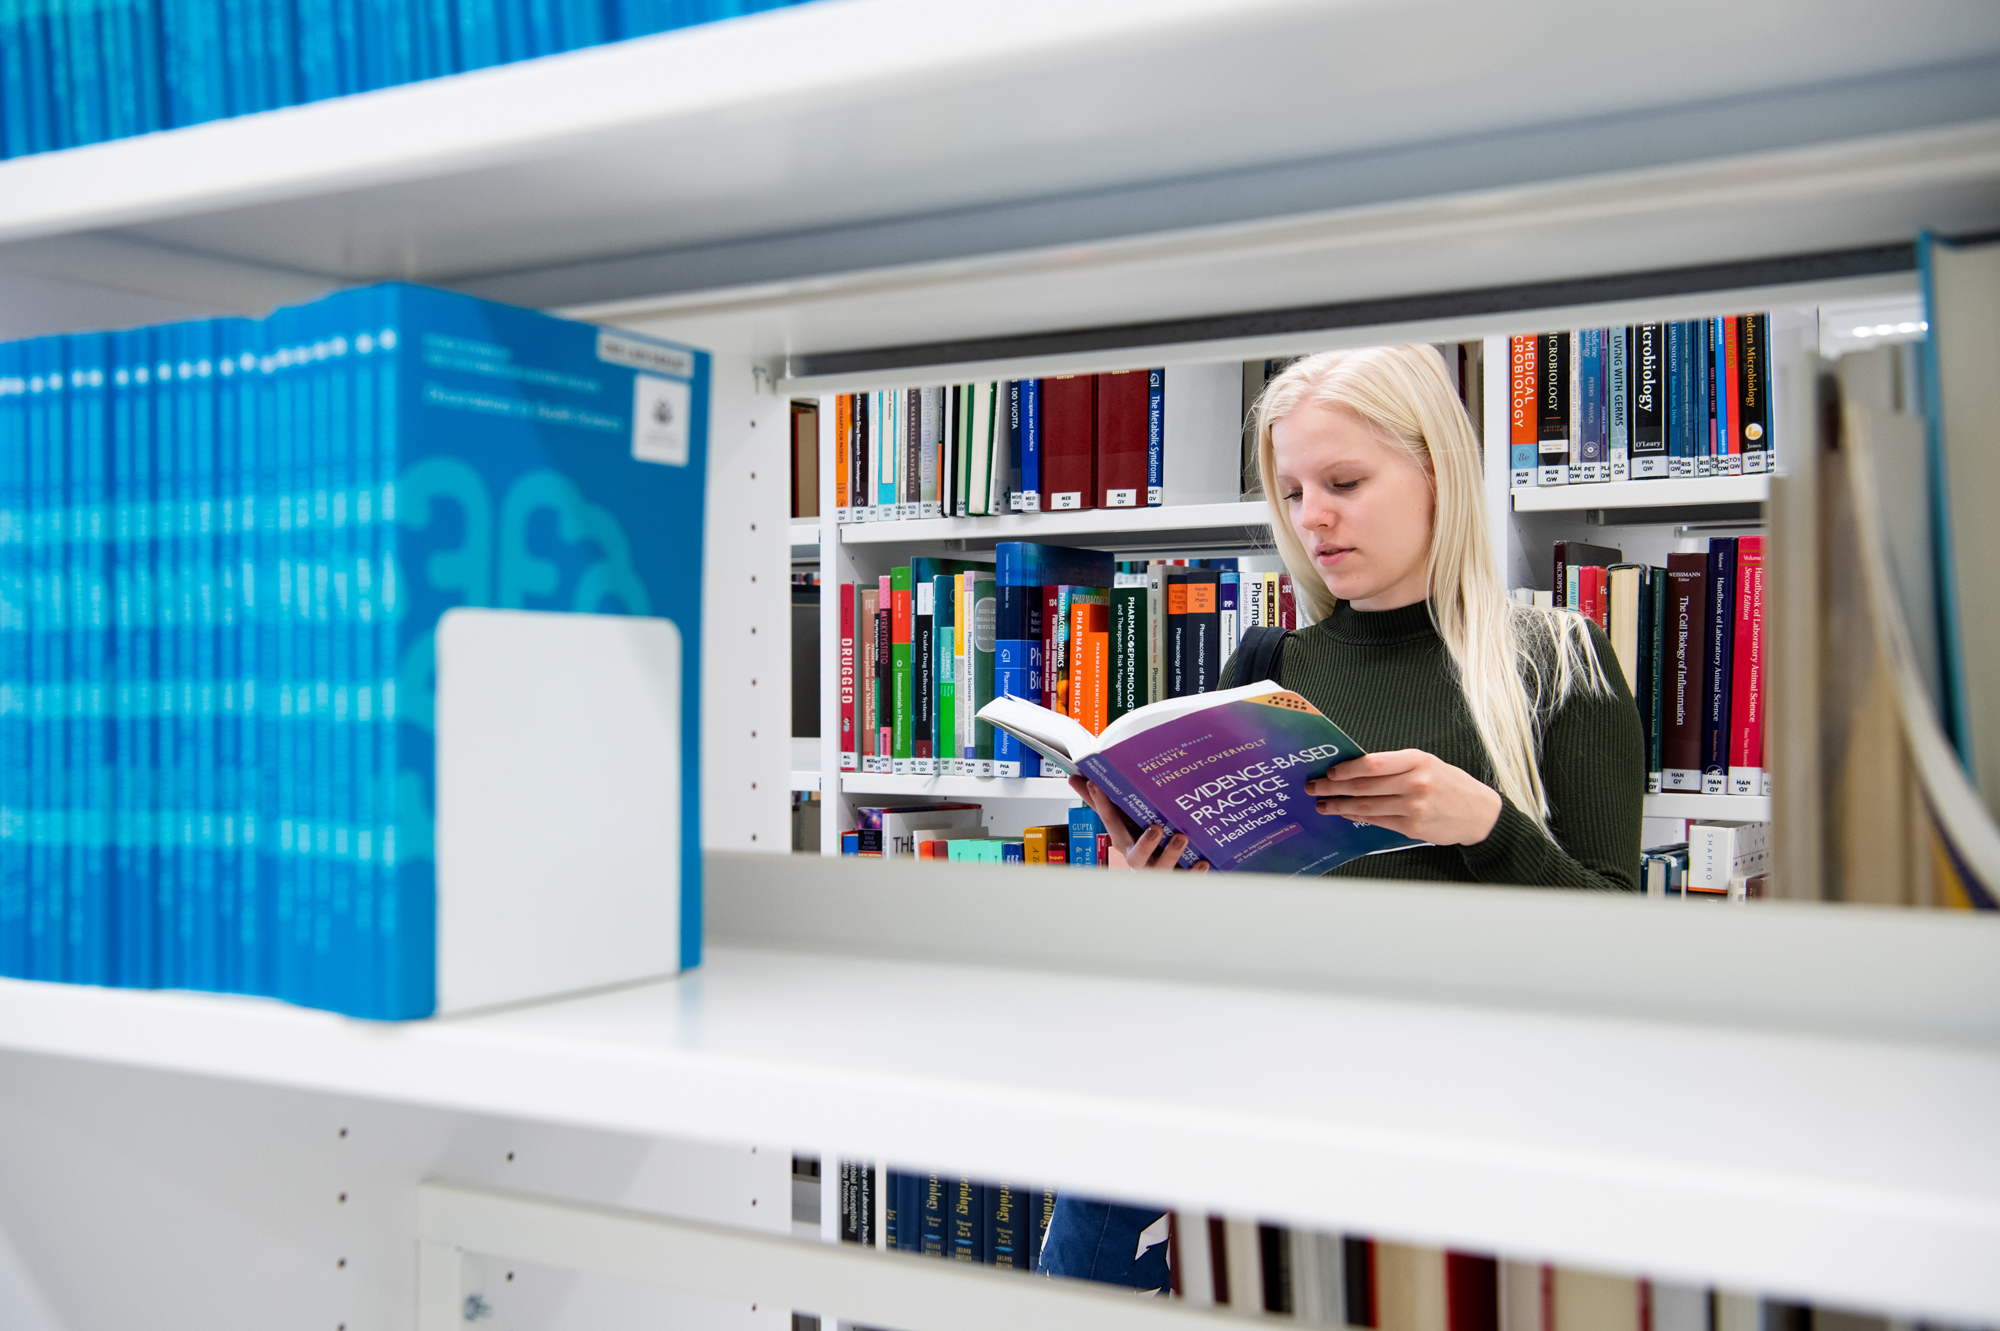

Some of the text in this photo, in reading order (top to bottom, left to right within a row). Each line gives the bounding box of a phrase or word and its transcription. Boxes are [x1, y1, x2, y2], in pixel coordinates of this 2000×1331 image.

[1525, 341, 1534, 404] MEDICAL
[1726, 323, 1734, 369] ALLERGIAT
[1514, 335, 1524, 428] CROBIOLOGY
[1614, 336, 1623, 427] LIVING WITH GERMS
[1746, 346, 1757, 408] Microbiology
[922, 388, 933, 484] mielen muuttajat
[1149, 395, 1160, 483] The Metabolic Syndrome
[1282, 584, 1292, 594] 202
[1743, 567, 1752, 620] Second Edition
[880, 611, 888, 664] MYRKYTYSTIETO
[1057, 592, 1066, 667] PHARMACOECONOMICS
[1127, 596, 1135, 713] PHARMACOEPIDEMIOLOGY
[1712, 577, 1725, 722] Handbook of Laboratory Animal Science
[1749, 567, 1763, 723] Handbook of Laboratory Animal Science
[841, 638, 853, 704] DRUGGED
[1676, 596, 1689, 725] The Cell Biology of Inflammation
[1141, 749, 1188, 774] MELNYK
[1151, 769, 1171, 782] Ellen
[1155, 739, 1267, 788] FINEOUT-OVERHOLT
[1175, 744, 1340, 811] EVIDENCE-BASED
[1072, 823, 1093, 831] GUPTA
[1190, 775, 1289, 826] PRACTICE
[1204, 792, 1291, 837] in Nursing &
[1214, 808, 1287, 848] Healthcare
[1705, 833, 1714, 881] SHAPIRO
[848, 1185, 858, 1233] Susceptibility
[861, 1192, 869, 1225] Laboratory
[996, 1227, 1013, 1235] Volume
